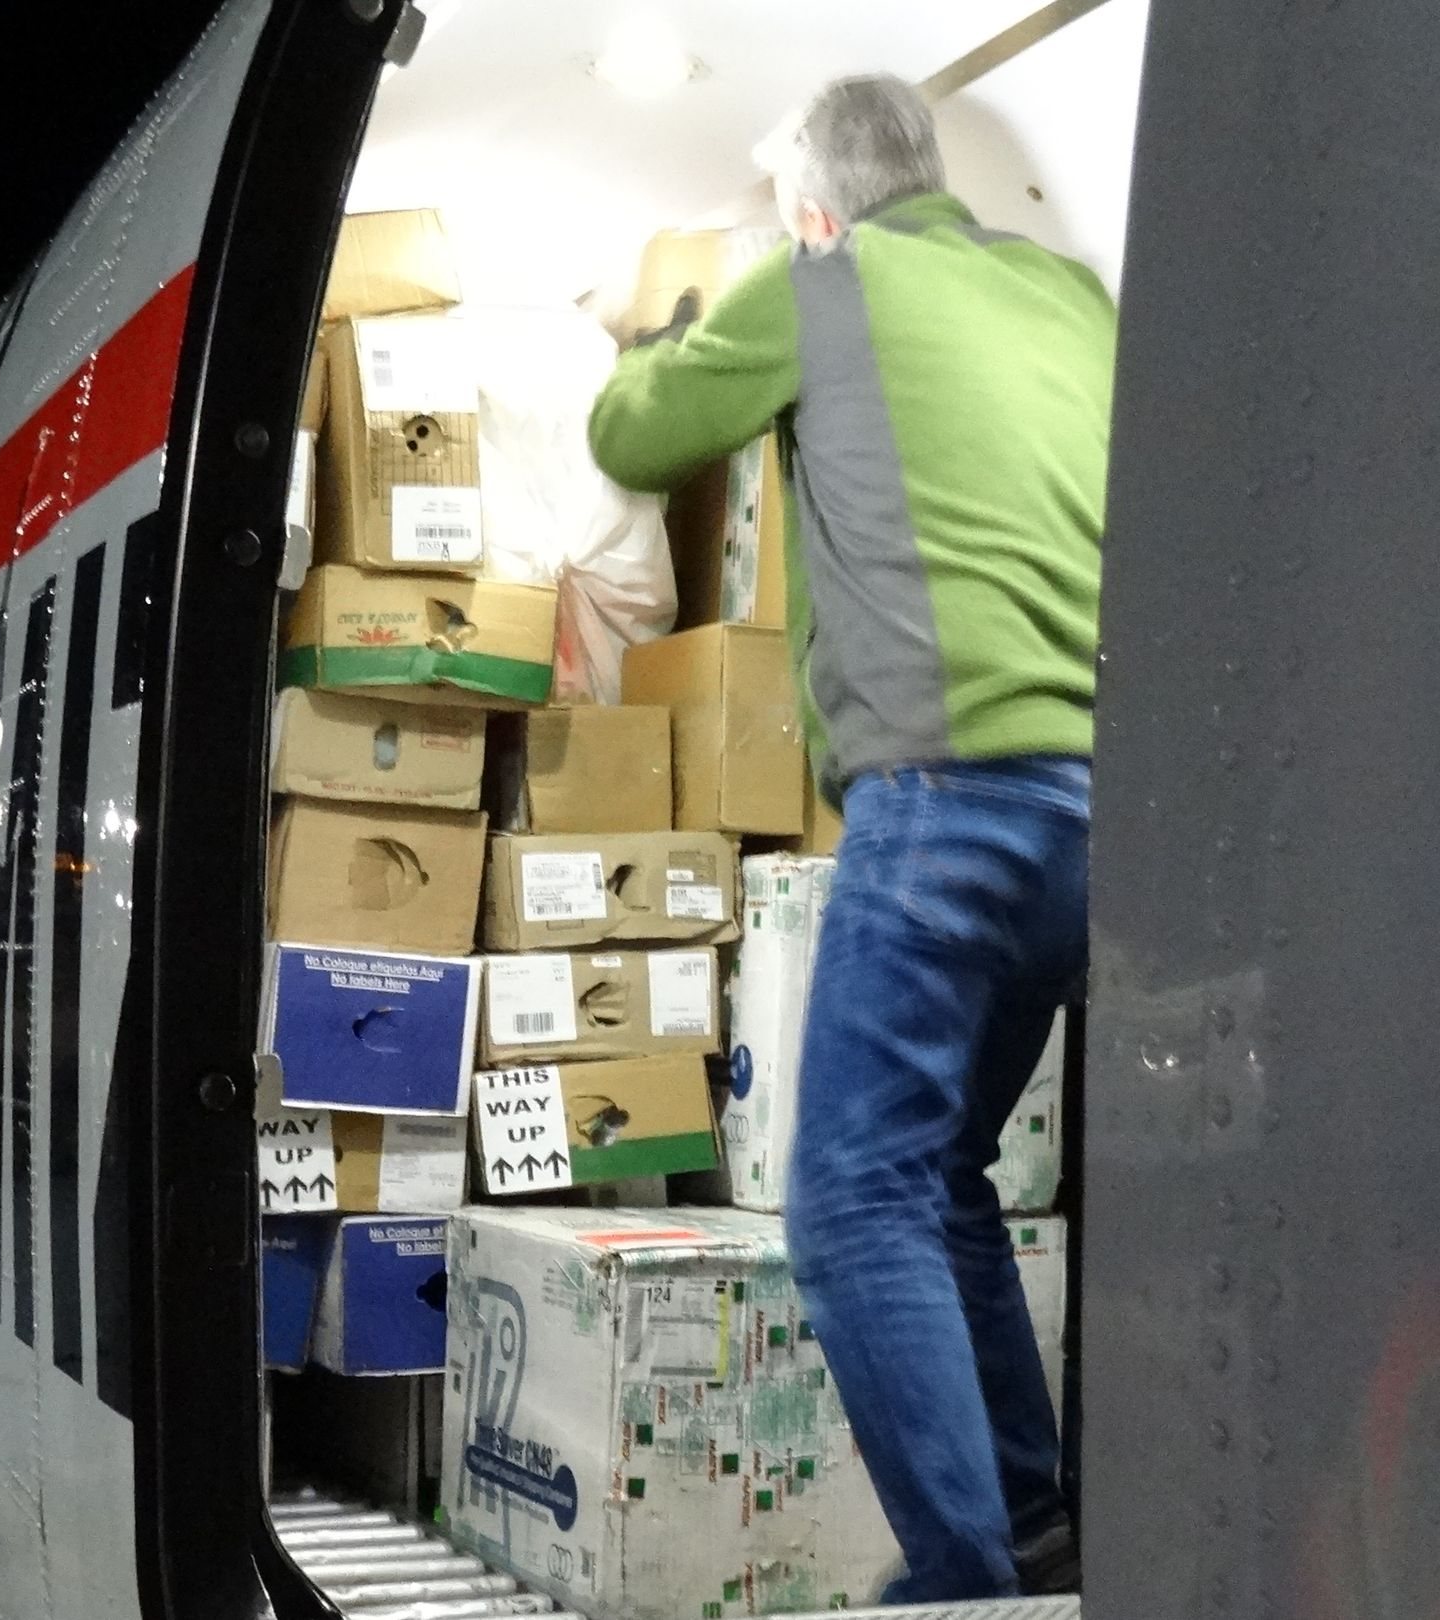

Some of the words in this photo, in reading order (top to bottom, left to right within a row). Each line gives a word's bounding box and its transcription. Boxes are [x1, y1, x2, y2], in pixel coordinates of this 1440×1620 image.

[304, 954, 320, 967] No
[321, 956, 368, 972] Coloque
[370, 961, 419, 977] etiquetas
[331, 972, 347, 986] No
[349, 973, 382, 988] labels
[384, 977, 411, 991] Here
[483, 1069, 550, 1089] THIS
[486, 1096, 552, 1118] WAY
[258, 1118, 320, 1138] WAY
[508, 1125, 546, 1144] UP
[275, 1147, 313, 1164] UP
[368, 1226, 385, 1240] No
[386, 1226, 430, 1239] Coloque
[396, 1240, 413, 1254] No
